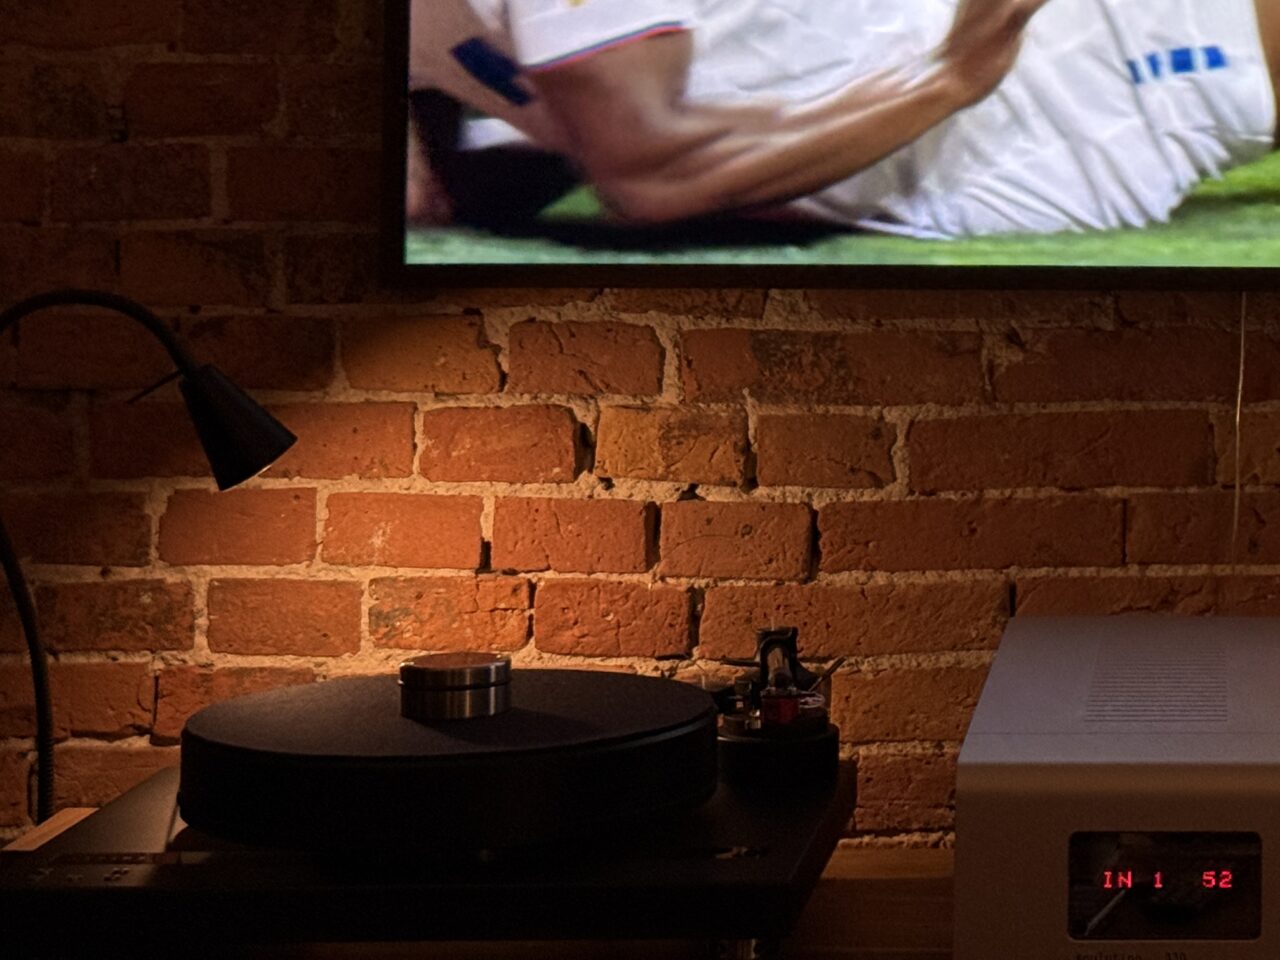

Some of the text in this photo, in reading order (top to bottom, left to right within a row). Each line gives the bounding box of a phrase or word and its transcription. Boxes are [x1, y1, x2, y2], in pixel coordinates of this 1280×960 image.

[1103, 870, 1234, 889] IN 1 52
